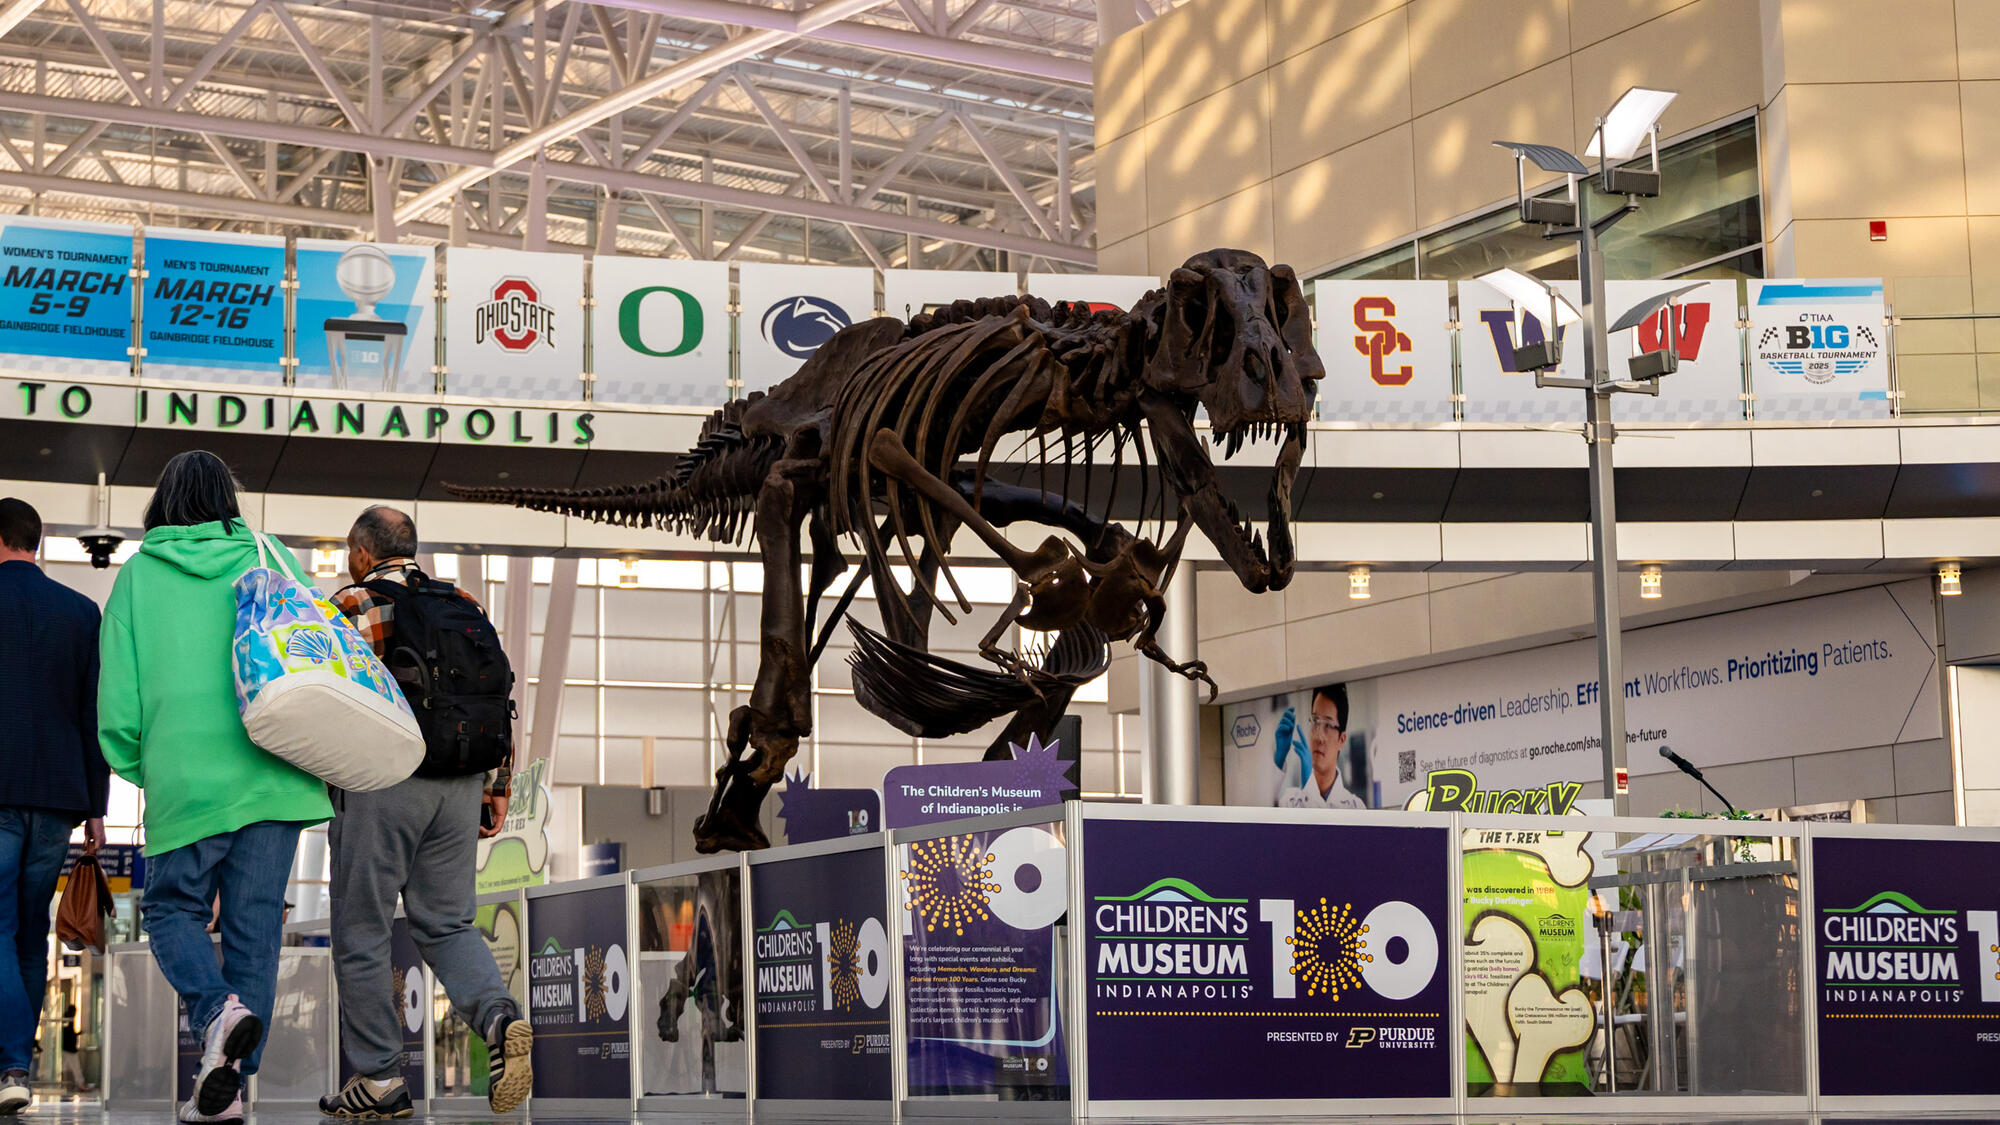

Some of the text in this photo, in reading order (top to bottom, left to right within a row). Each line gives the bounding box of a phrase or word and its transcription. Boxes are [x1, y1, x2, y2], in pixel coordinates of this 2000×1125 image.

[3, 246, 128, 265] WOMEN'S TOURNAMENT
[164, 259, 269, 276] MEN'S TOURNAMENT
[3, 265, 126, 295] MARCH
[153, 277, 275, 306] MARCH
[29, 293, 90, 317] 5-9
[169, 304, 251, 329] 12-16
[1810, 314, 1834, 322] TIAA
[0, 319, 126, 338] GAINBRIDGE FIELDHOUSE
[150, 331, 275, 349] GAINBRIDGE FIELDHOUSE
[1760, 351, 1877, 360] BASKETBALL TOURNAMENT
[18, 382, 595, 446] TO INDIANAPOLIS
[1397, 640, 1893, 734] Science-driven Leadership. Effnt Workflows. Prioritizing Patients.
[1236, 723, 1256, 737] Roche
[1420, 759, 1433, 772] See
[1434, 757, 1447, 770] the
[1447, 754, 1469, 769] future
[1470, 752, 1477, 766] of
[1478, 747, 1519, 765] diagnostics
[1520, 748, 1528, 759] at
[901, 785, 1042, 798] The Children's Museum
[920, 803, 934, 815] of
[937, 803, 1010, 817] Indianapolis
[1479, 831, 1501, 844] THE
[1484, 886, 1525, 894] discovered
[1096, 904, 1248, 933] CHILDREN'S
[1538, 919, 1575, 927] CHILDREN'S
[1824, 916, 1958, 943] CHILDREN'S
[757, 931, 813, 959] CHILDREN'S
[928, 945, 960, 954] celebrating
[1002, 945, 1010, 953] all
[531, 955, 572, 979] CHILDREN'S
[909, 956, 923, 964] long
[938, 956, 959, 964] special
[1097, 943, 1249, 975] MUSEUM
[1826, 952, 1959, 980] MUSEUM
[758, 964, 814, 993] MUSEUM
[909, 966, 936, 974] including
[1009, 976, 1027, 984] Bucky
[532, 983, 573, 1008] MUSEUM
[990, 1007, 1006, 1015] story
[932, 1016, 954, 1025] largest
[866, 1034, 890, 1047] PURDUE
[1266, 1032, 1323, 1042] PRESENTED
[1326, 1032, 1339, 1042] BY
[1379, 1028, 1435, 1041] PURDUE
[1379, 1041, 1436, 1049] UNIVERSITY
